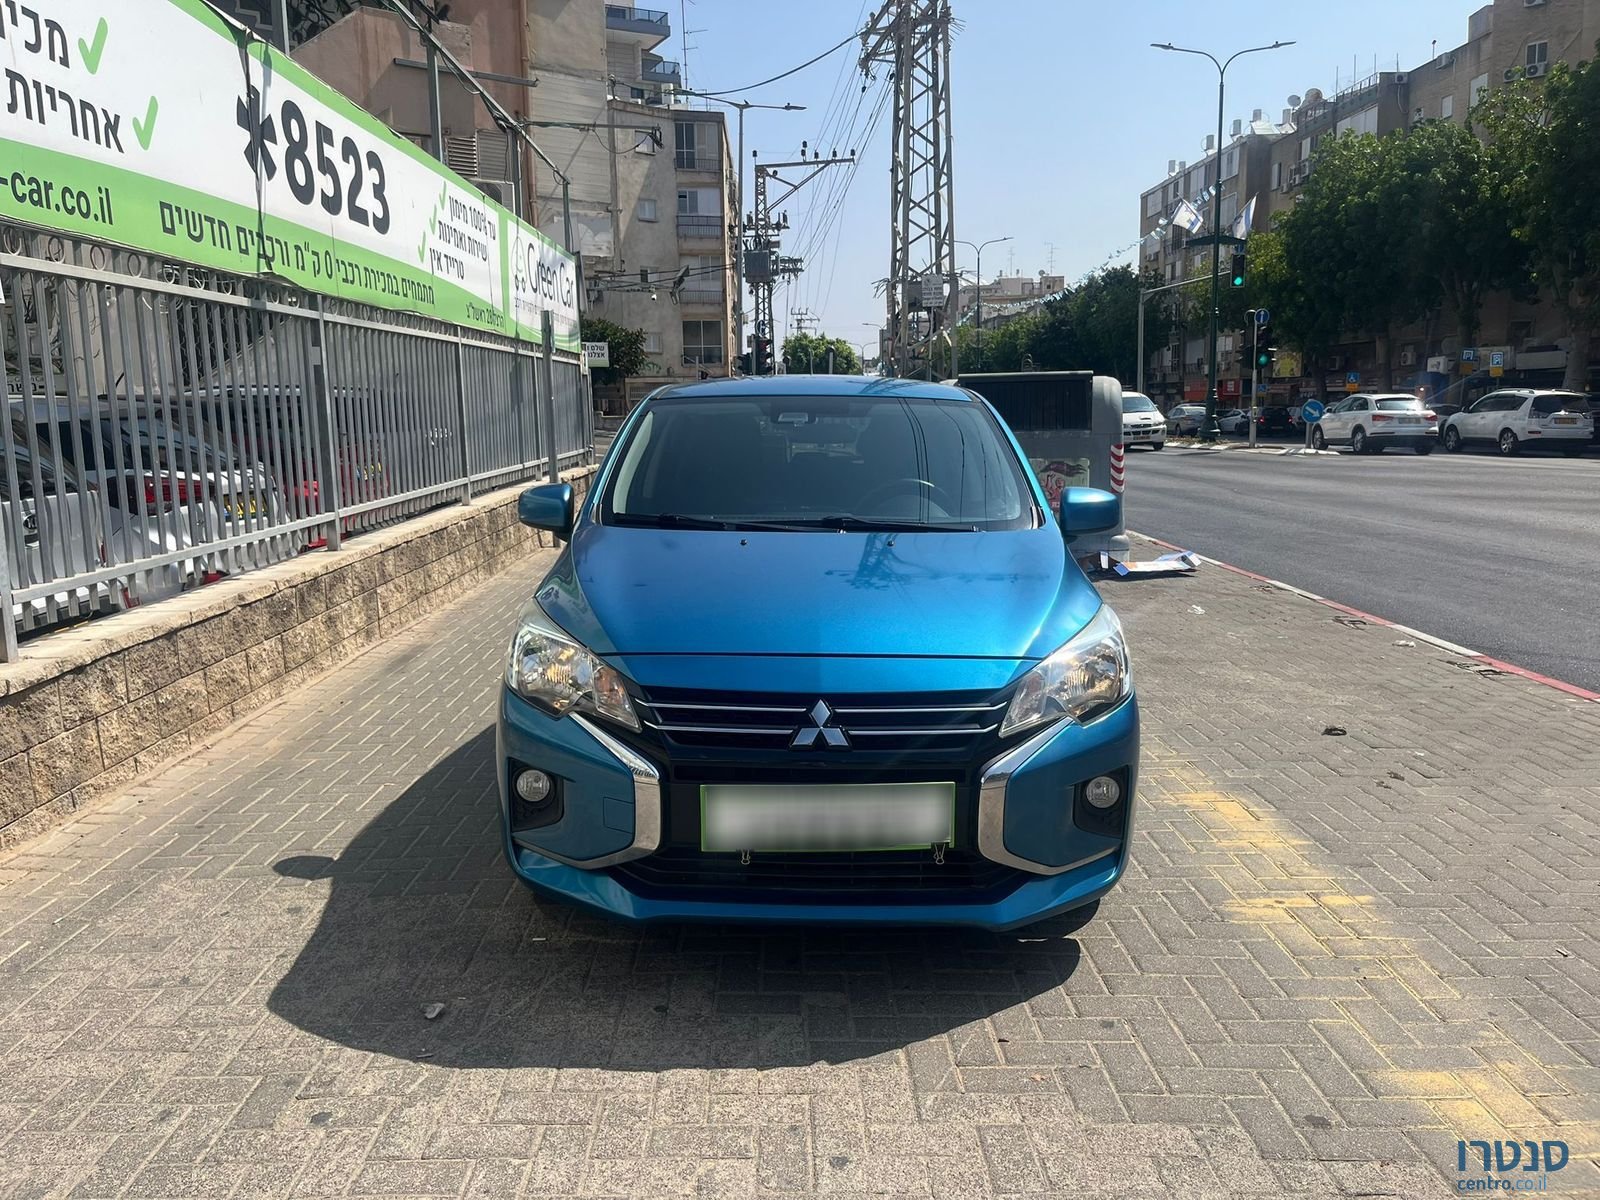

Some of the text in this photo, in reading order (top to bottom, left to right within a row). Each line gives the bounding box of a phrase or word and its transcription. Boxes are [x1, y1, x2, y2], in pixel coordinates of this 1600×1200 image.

[5, 67, 125, 154] אחריות
[449, 195, 468, 224] מימון
[159, 200, 232, 251] חדשים
[438, 220, 487, 262] שירות ואמינות
[488, 220, 496, 240] עד
[236, 225, 290, 268] ורכבים
[324, 250, 333, 280] 0
[336, 258, 362, 287] רכבי
[430, 247, 465, 280] טרייד אין
[527, 242, 574, 310] Green Car
[364, 266, 400, 296] במכירת
[402, 277, 435, 305] מתמחים
